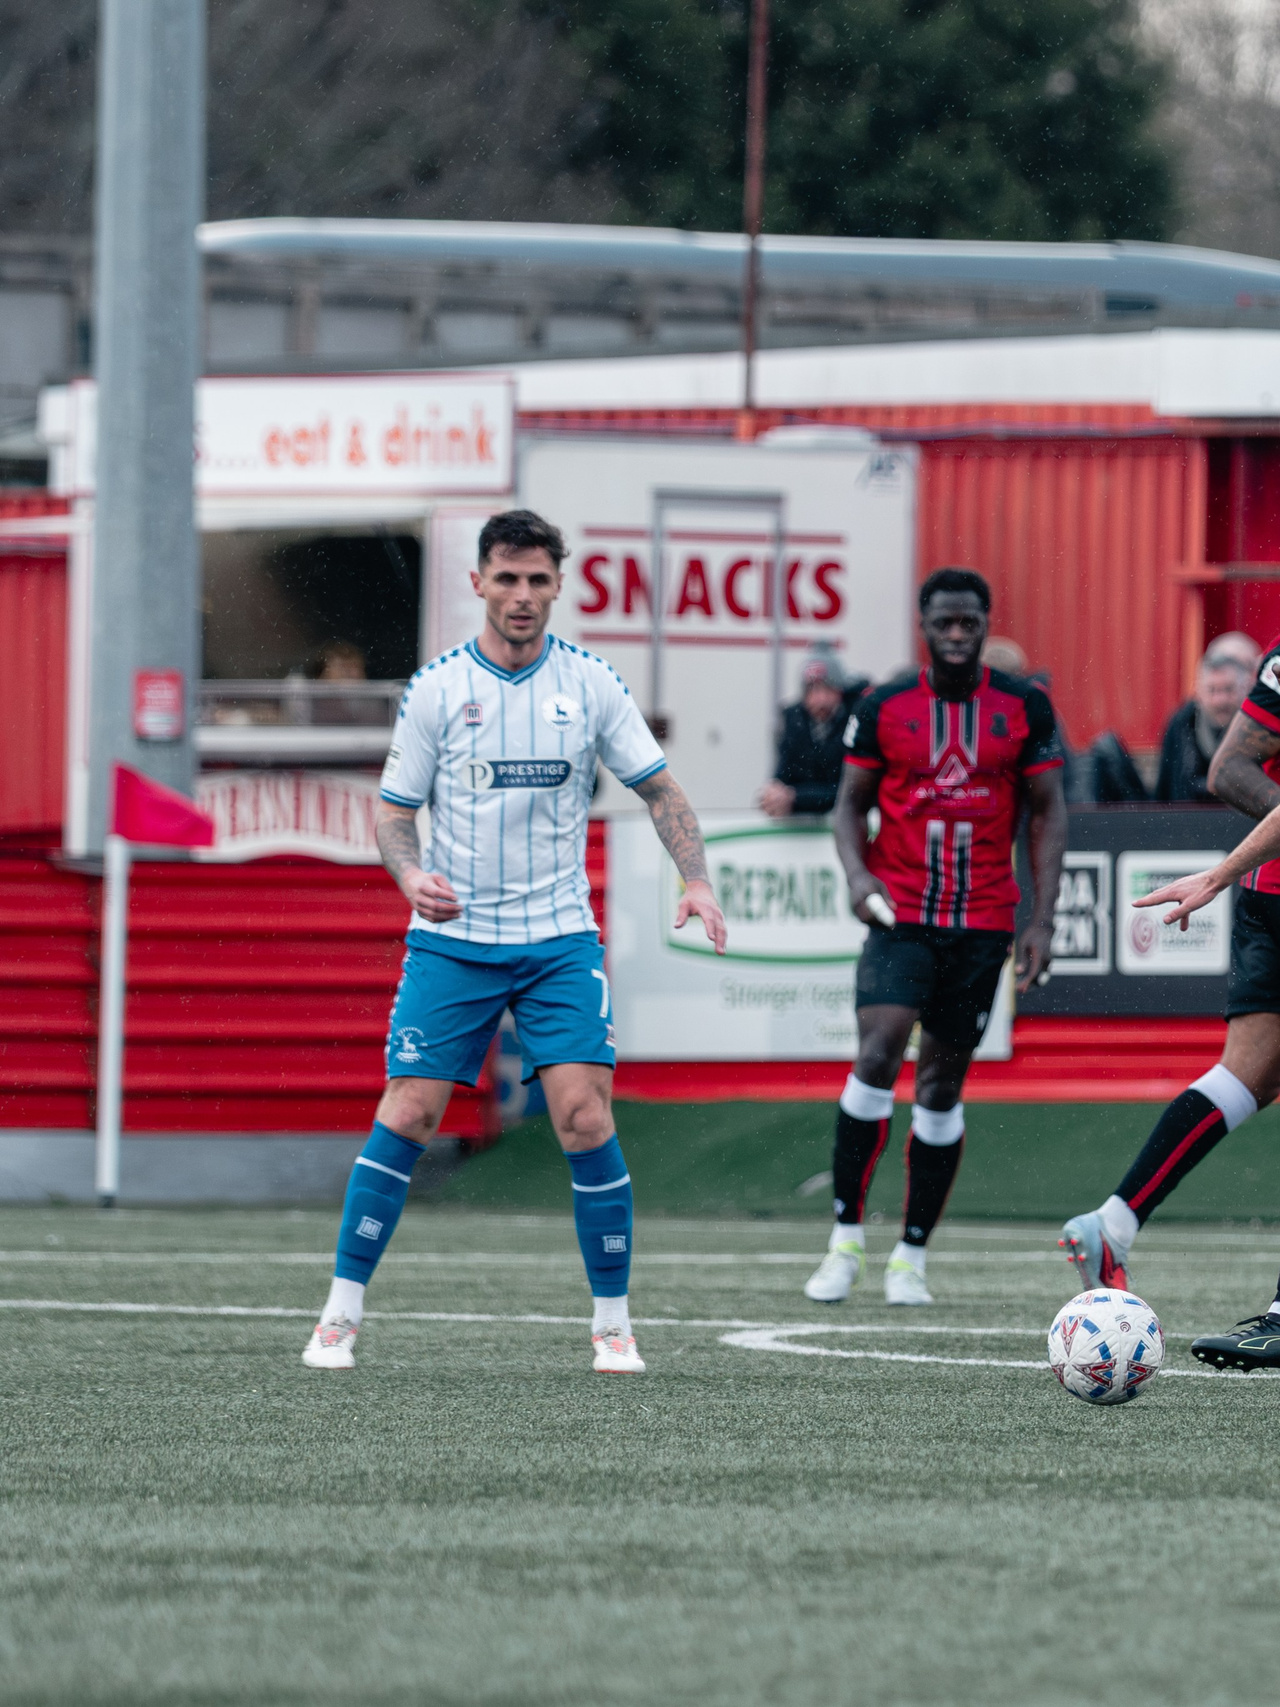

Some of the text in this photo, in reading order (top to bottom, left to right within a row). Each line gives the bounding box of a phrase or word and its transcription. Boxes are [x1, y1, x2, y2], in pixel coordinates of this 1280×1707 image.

[265, 414, 330, 466] eat
[345, 420, 368, 466] &
[383, 404, 494, 466] drink
[578, 554, 843, 620] SNACKS
[497, 763, 567, 776] PRESTIGE
[718, 864, 838, 922] REPAIR
[591, 968, 609, 1018] 7
